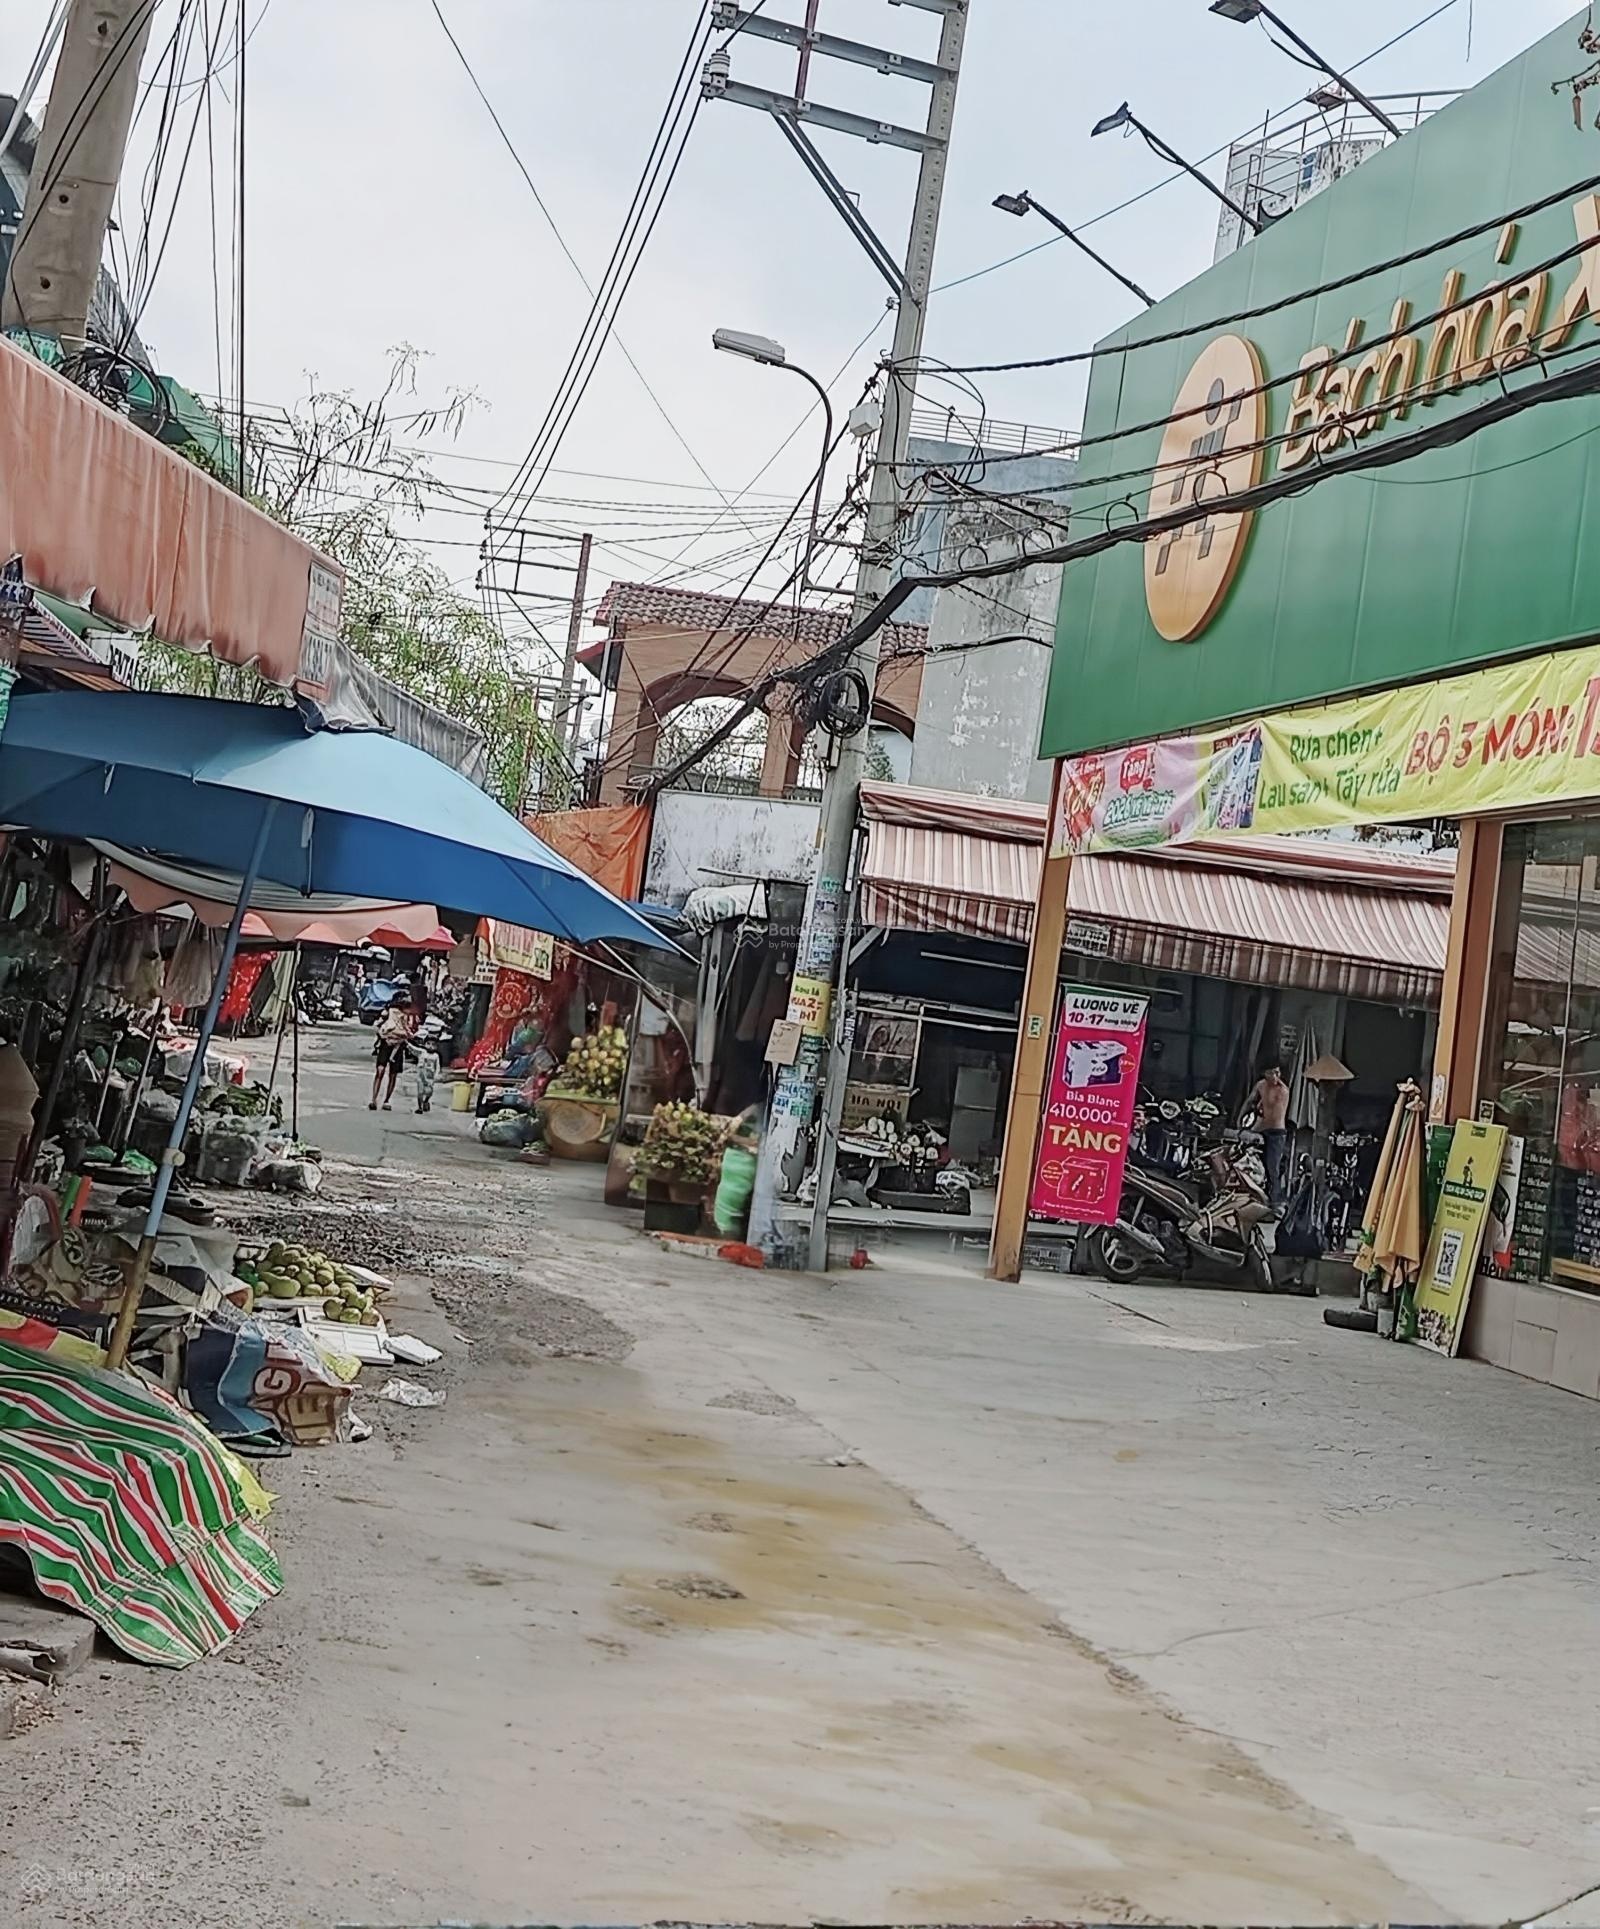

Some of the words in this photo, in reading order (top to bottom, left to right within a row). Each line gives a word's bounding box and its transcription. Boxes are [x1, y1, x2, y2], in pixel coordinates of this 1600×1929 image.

[1277, 297, 1418, 471] Bách
[1404, 714, 1451, 785] BỘ
[1452, 721, 1479, 768] 3
[1481, 697, 1575, 765] MÓN:
[1258, 780, 1286, 809] Lau
[1066, 1090, 1085, 1102] Bia
[1087, 1094, 1121, 1108] Blanc
[1048, 1122, 1122, 1154] TẶNG
